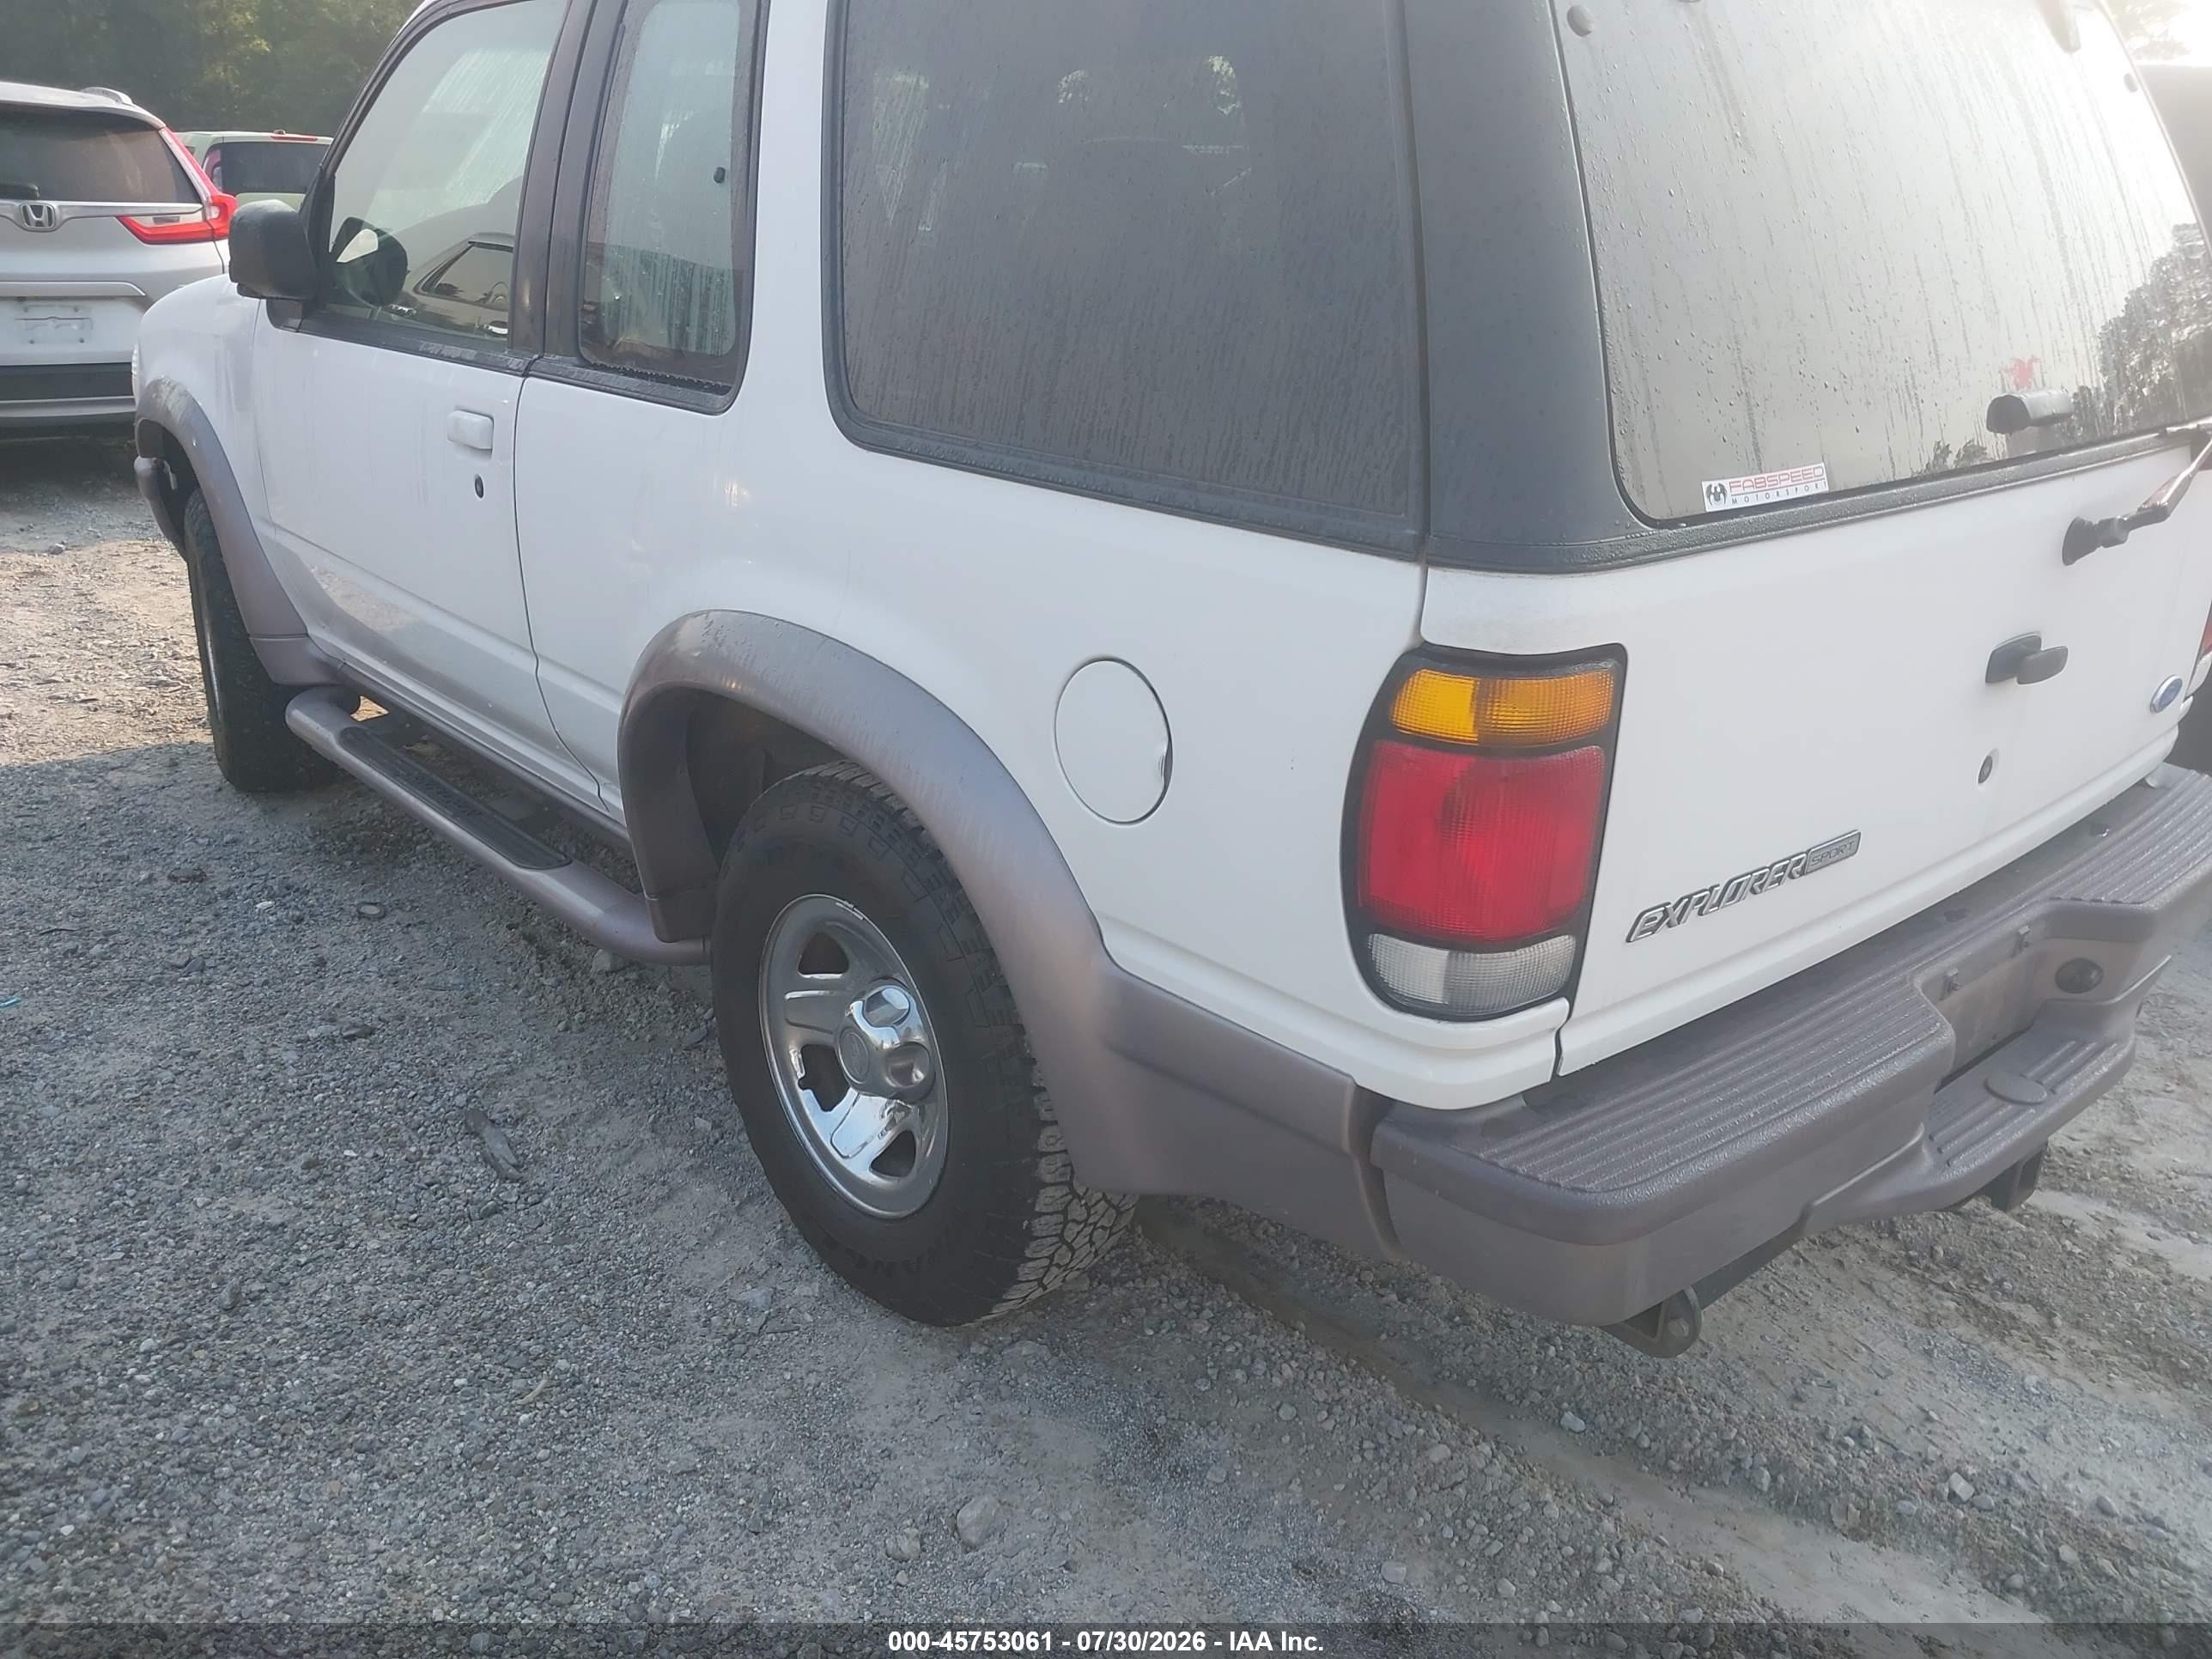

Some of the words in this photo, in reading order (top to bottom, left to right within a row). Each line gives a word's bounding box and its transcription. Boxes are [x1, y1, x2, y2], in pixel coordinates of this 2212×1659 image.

[1729, 466, 1824, 493] FABSPEED
[1732, 483, 1826, 504] MOTORSPORT
[1626, 852, 1807, 943] EXPLORER
[1812, 841, 1856, 866] SPORT
